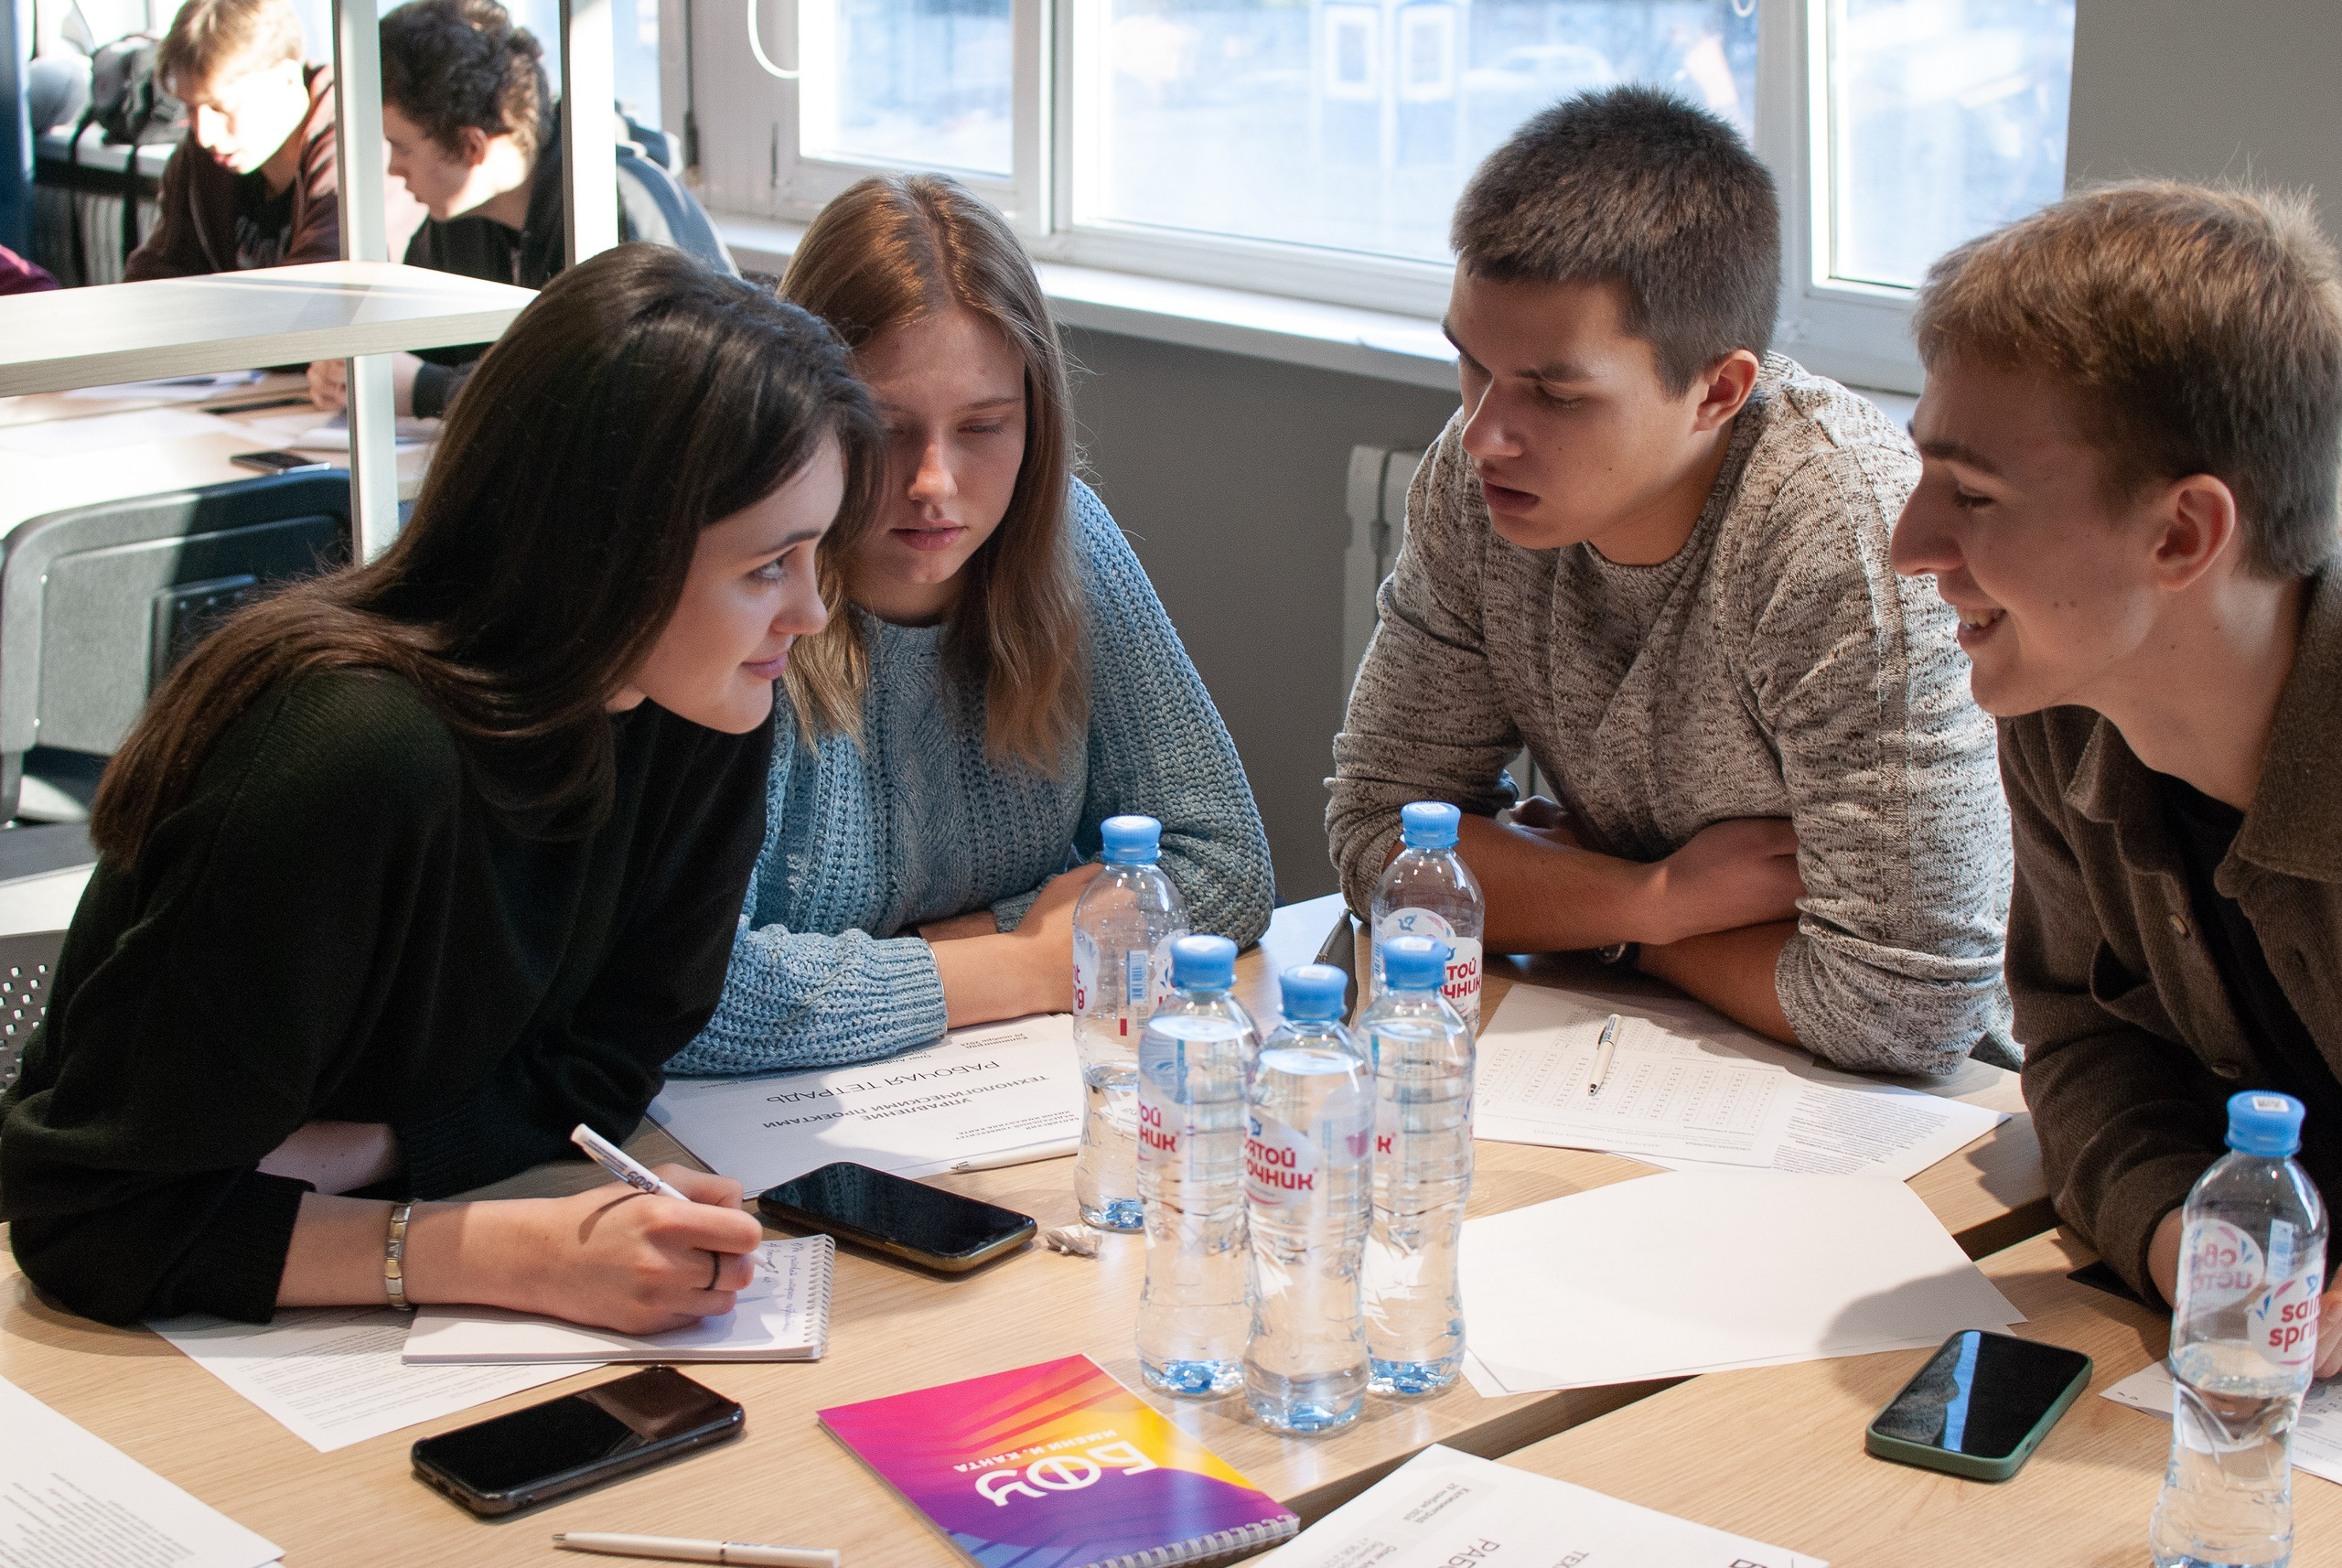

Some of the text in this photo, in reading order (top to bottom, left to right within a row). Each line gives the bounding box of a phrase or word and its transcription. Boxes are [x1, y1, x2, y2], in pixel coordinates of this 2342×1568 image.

[1444, 957, 1477, 981] той
[885, 1061, 1000, 1086] РАБОЧАЯ
[763, 1075, 1049, 1129] ТЕХНОЛОГИЧЕСКИМИ ПРОЕКТАМИ
[767, 1081, 883, 1103] ТЕТРАДЬ
[859, 1098, 972, 1122] УПРАВЛЕНИЕ
[1047, 1429, 1118, 1451] ИМЕНИ
[952, 1451, 1020, 1473] КАНТА
[974, 1440, 1158, 1507] БФУ
[1439, 1539, 1501, 1568] РАБ
